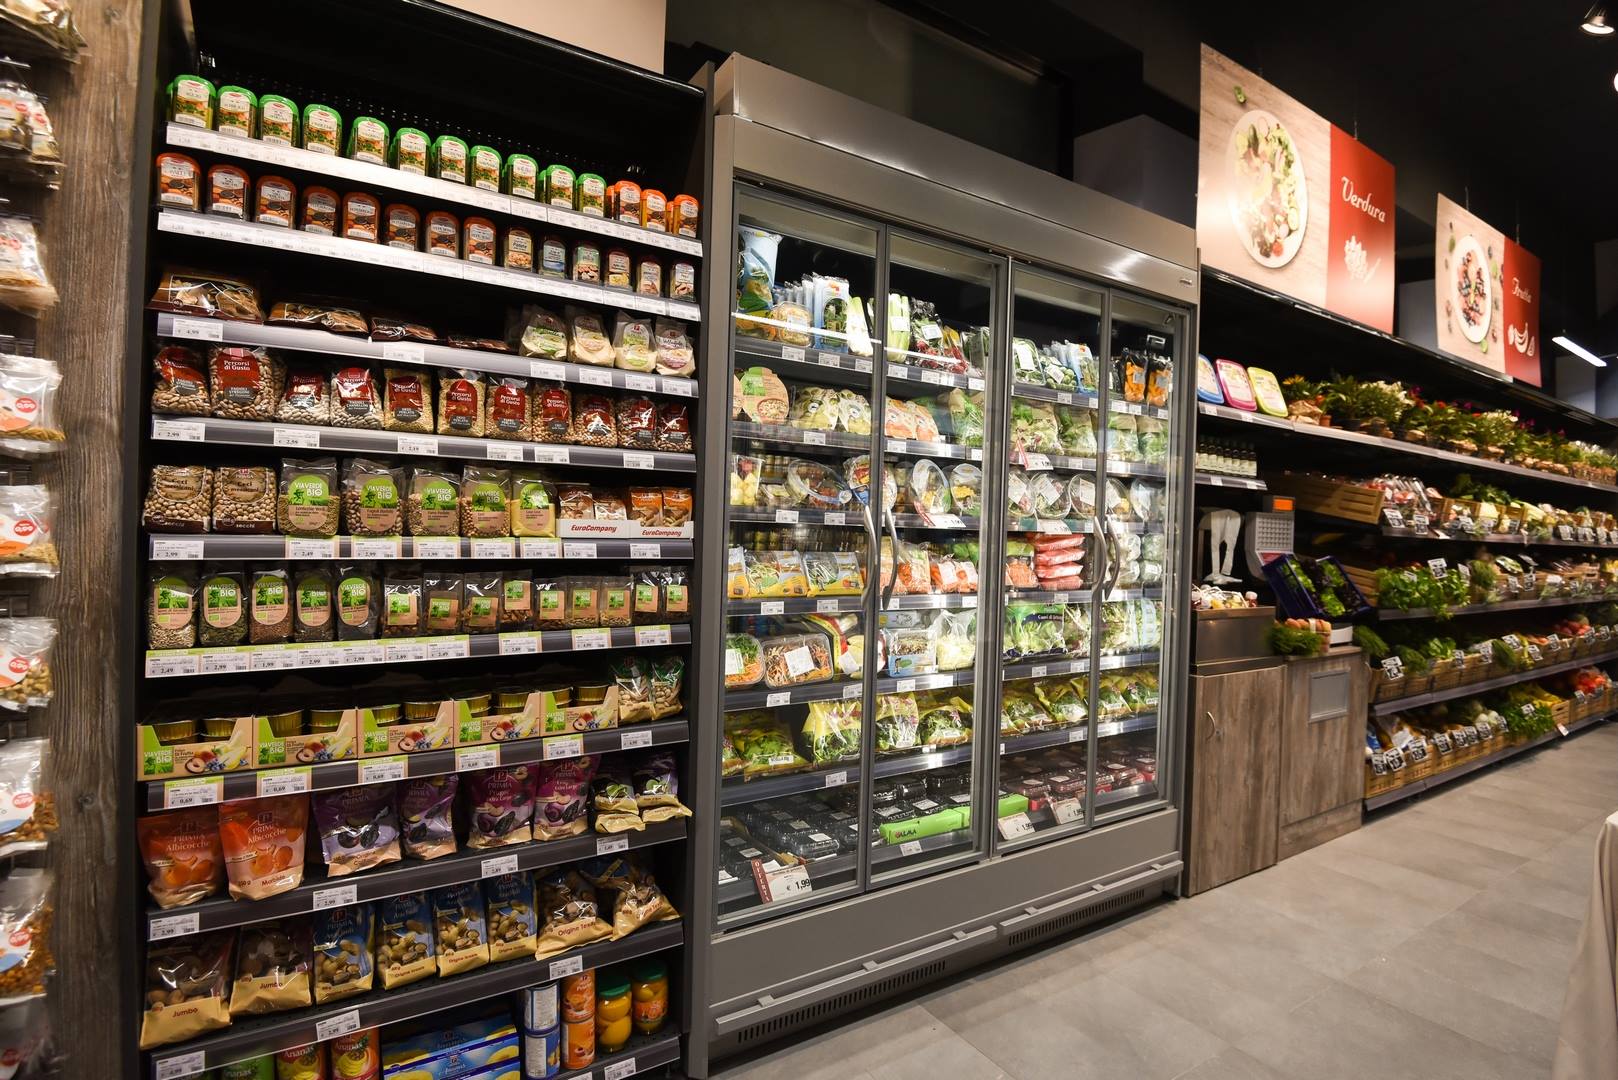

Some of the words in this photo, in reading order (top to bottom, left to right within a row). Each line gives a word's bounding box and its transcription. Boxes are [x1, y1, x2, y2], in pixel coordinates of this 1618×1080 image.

[1341, 176, 1386, 223] Verdura
[1512, 277, 1532, 304] Frutta
[306, 488, 323, 497] BIO
[377, 491, 393, 500] BIO
[437, 493, 452, 501] BIO
[486, 495, 500, 503] BIO
[571, 524, 618, 533] EuroCompany
[642, 529, 683, 537] EuroCompany
[219, 588, 236, 597] BIO
[267, 587, 283, 595] BIO
[351, 588, 366, 596] BIO
[248, 828, 287, 843] Albicocche
[166, 841, 210, 852] Albicocche
[795, 878, 811, 890] 1,99
[558, 925, 581, 937] Origine
[259, 981, 283, 990] Jumbo
[172, 1007, 198, 1018] Jumbo
[335, 1041, 363, 1051] Ananas
[284, 1045, 315, 1058] Ananas
